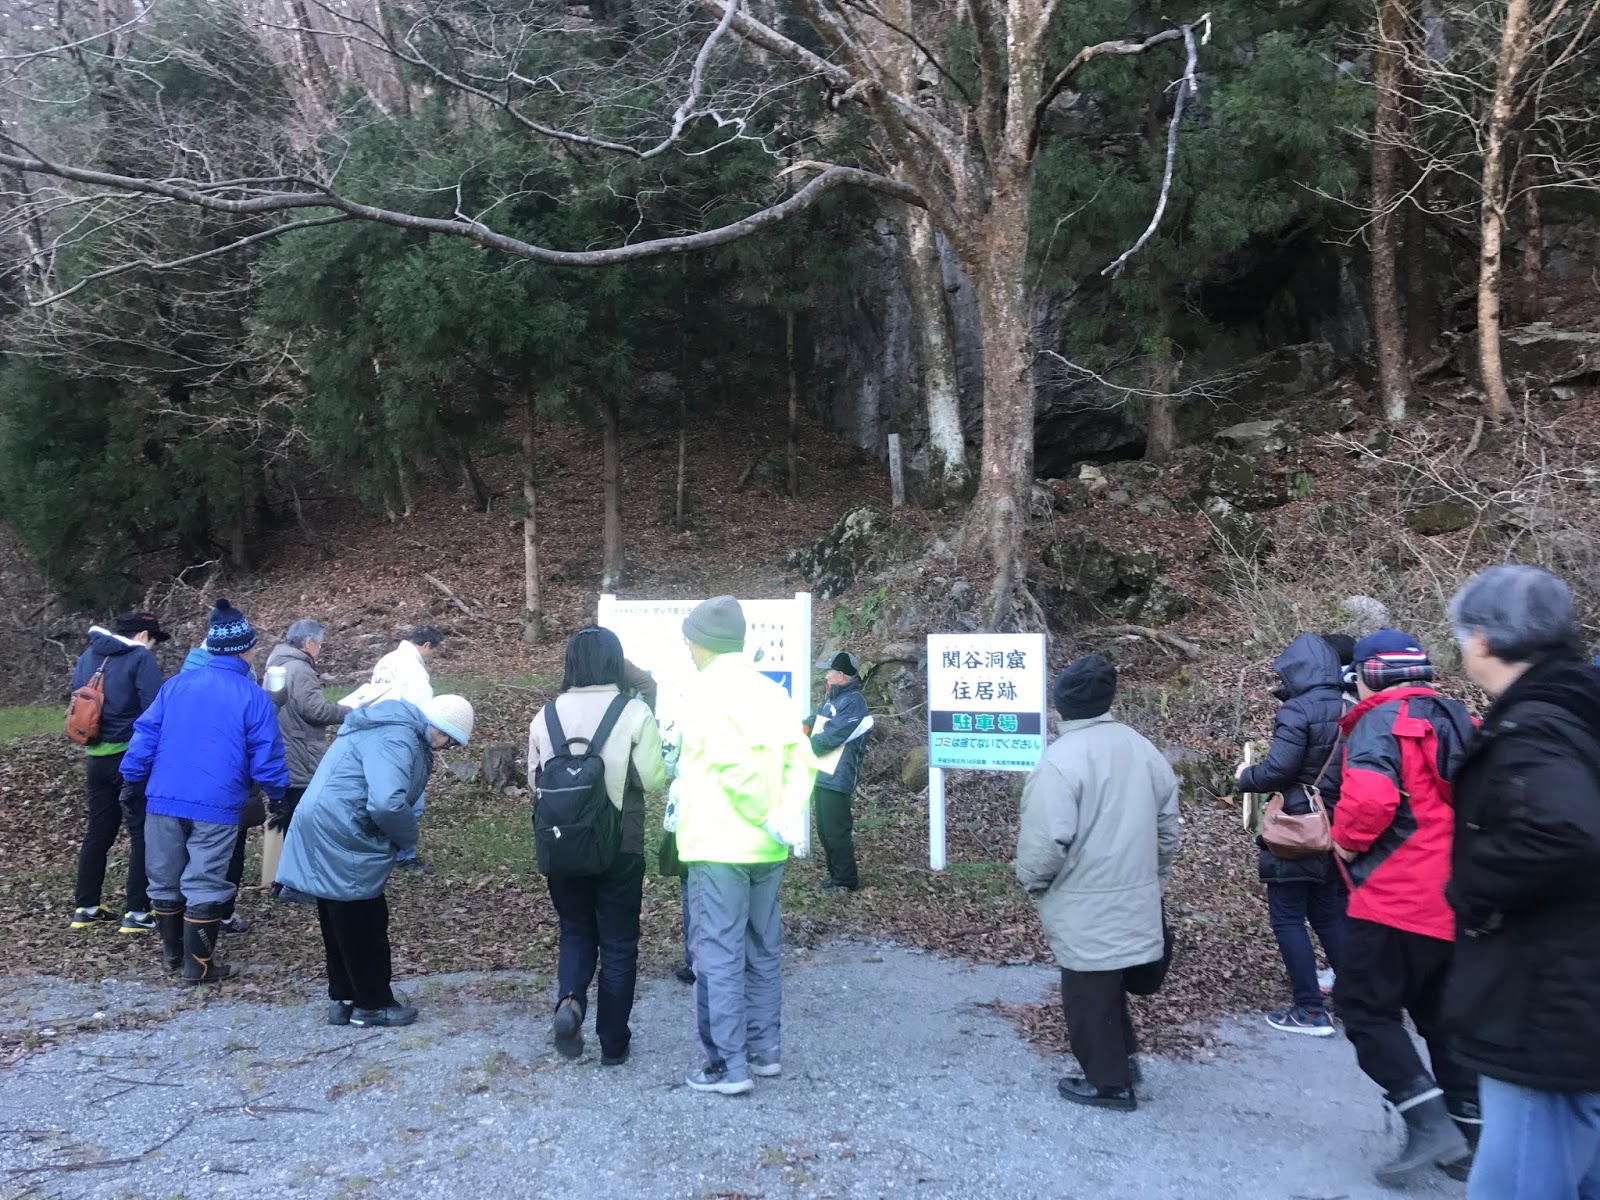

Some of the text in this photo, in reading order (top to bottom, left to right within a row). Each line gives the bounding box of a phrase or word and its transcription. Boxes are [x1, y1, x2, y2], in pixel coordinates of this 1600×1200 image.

[224, 643, 249, 652] SNOW
[942, 649, 1026, 669] 関谷洞窟
[951, 681, 1018, 701] 住居跡
[952, 713, 1018, 732] 駐車場
[934, 737, 1040, 750] ゴミは捨てないでください。
